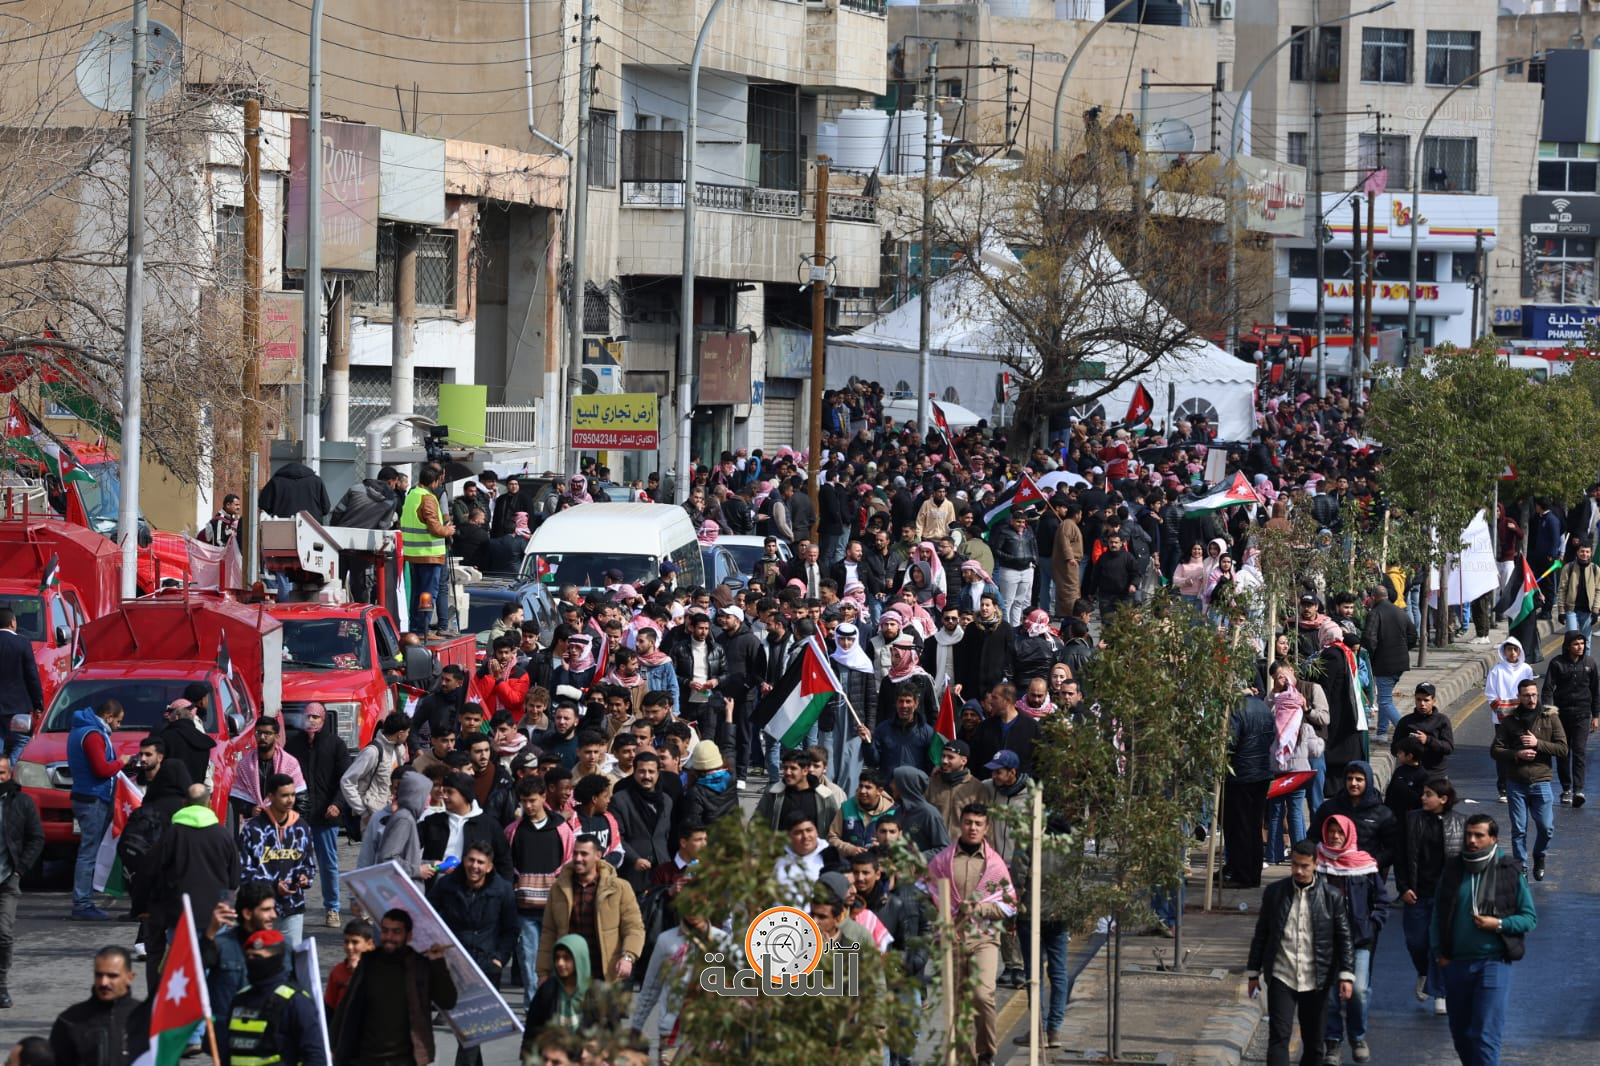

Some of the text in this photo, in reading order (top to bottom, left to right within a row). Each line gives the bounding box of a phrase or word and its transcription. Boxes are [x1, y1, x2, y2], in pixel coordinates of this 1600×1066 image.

[320, 135, 365, 202] ROYAL
[1494, 309, 1521, 322] 309
[1547, 330, 1586, 339] PHARMA
[576, 402, 654, 424] أرض تجاري للبيع
[574, 433, 617, 444] 0795042344
